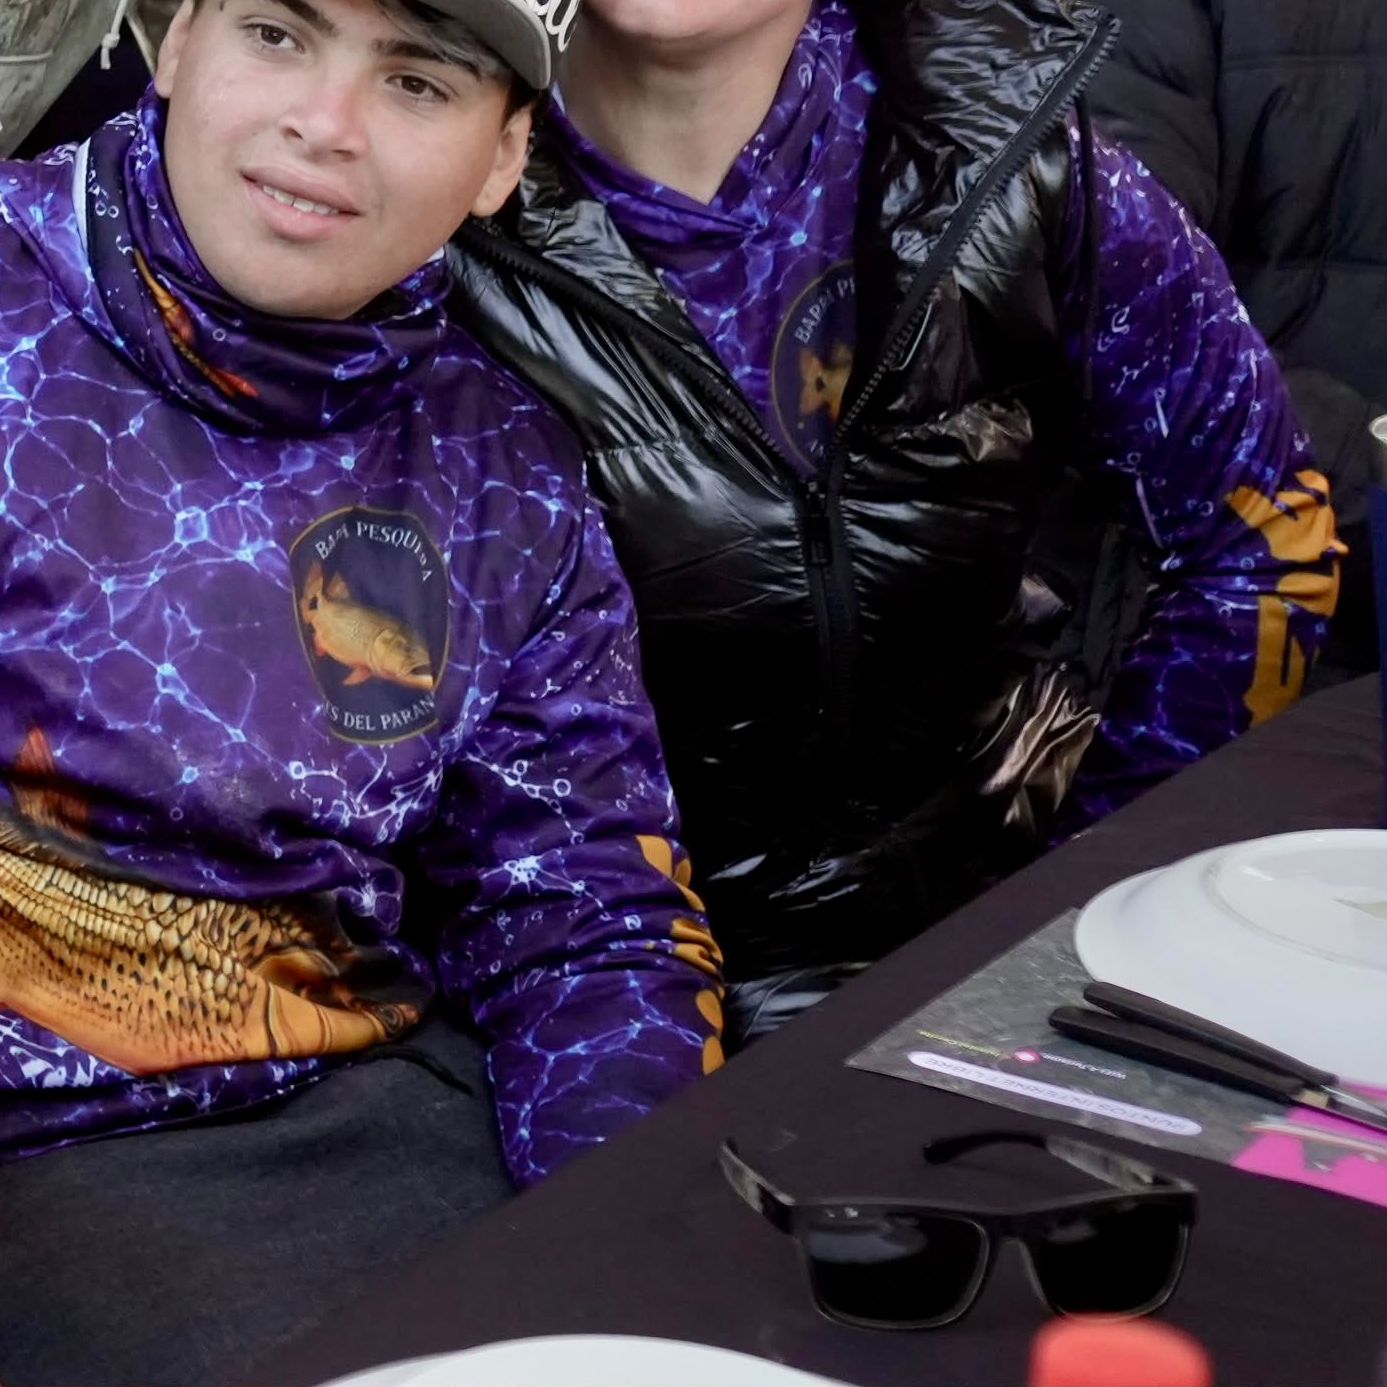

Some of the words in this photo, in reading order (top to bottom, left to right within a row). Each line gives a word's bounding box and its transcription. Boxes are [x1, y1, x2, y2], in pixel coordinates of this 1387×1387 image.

[343, 711, 376, 731] DEL
[380, 690, 436, 730] PARAN
[923, 1058, 985, 1079] LIBRE
[991, 1076, 1094, 1107] INTERNET
[1097, 1104, 1187, 1131] PUNTOS
